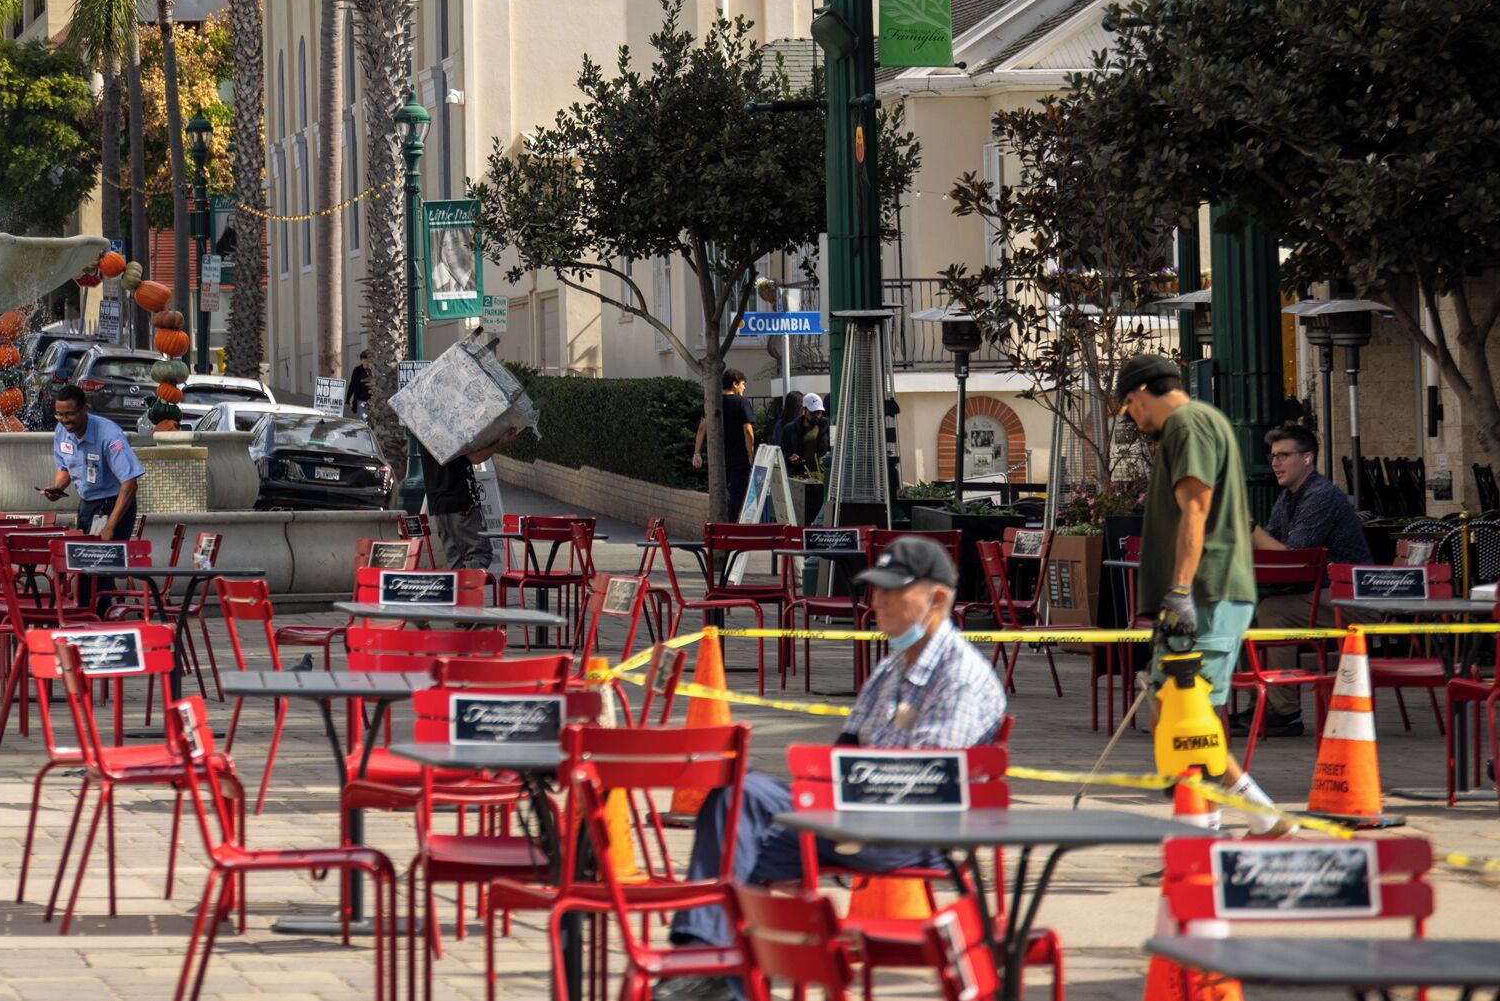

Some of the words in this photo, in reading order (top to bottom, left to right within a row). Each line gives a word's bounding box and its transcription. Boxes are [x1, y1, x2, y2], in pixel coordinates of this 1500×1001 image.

[883, 27, 947, 52] Famiglia
[428, 204, 451, 221] Little
[484, 297, 491, 306] 2
[484, 308, 506, 316] PARKING
[748, 316, 811, 331] COLUMBIA
[400, 370, 414, 383] NO
[316, 385, 330, 397] NO
[315, 397, 343, 406] PARKING
[73, 547, 118, 568] Famiglia
[389, 577, 447, 602] Famiglia
[1361, 571, 1417, 597] Famiglia
[847, 759, 949, 805] Famiglia
